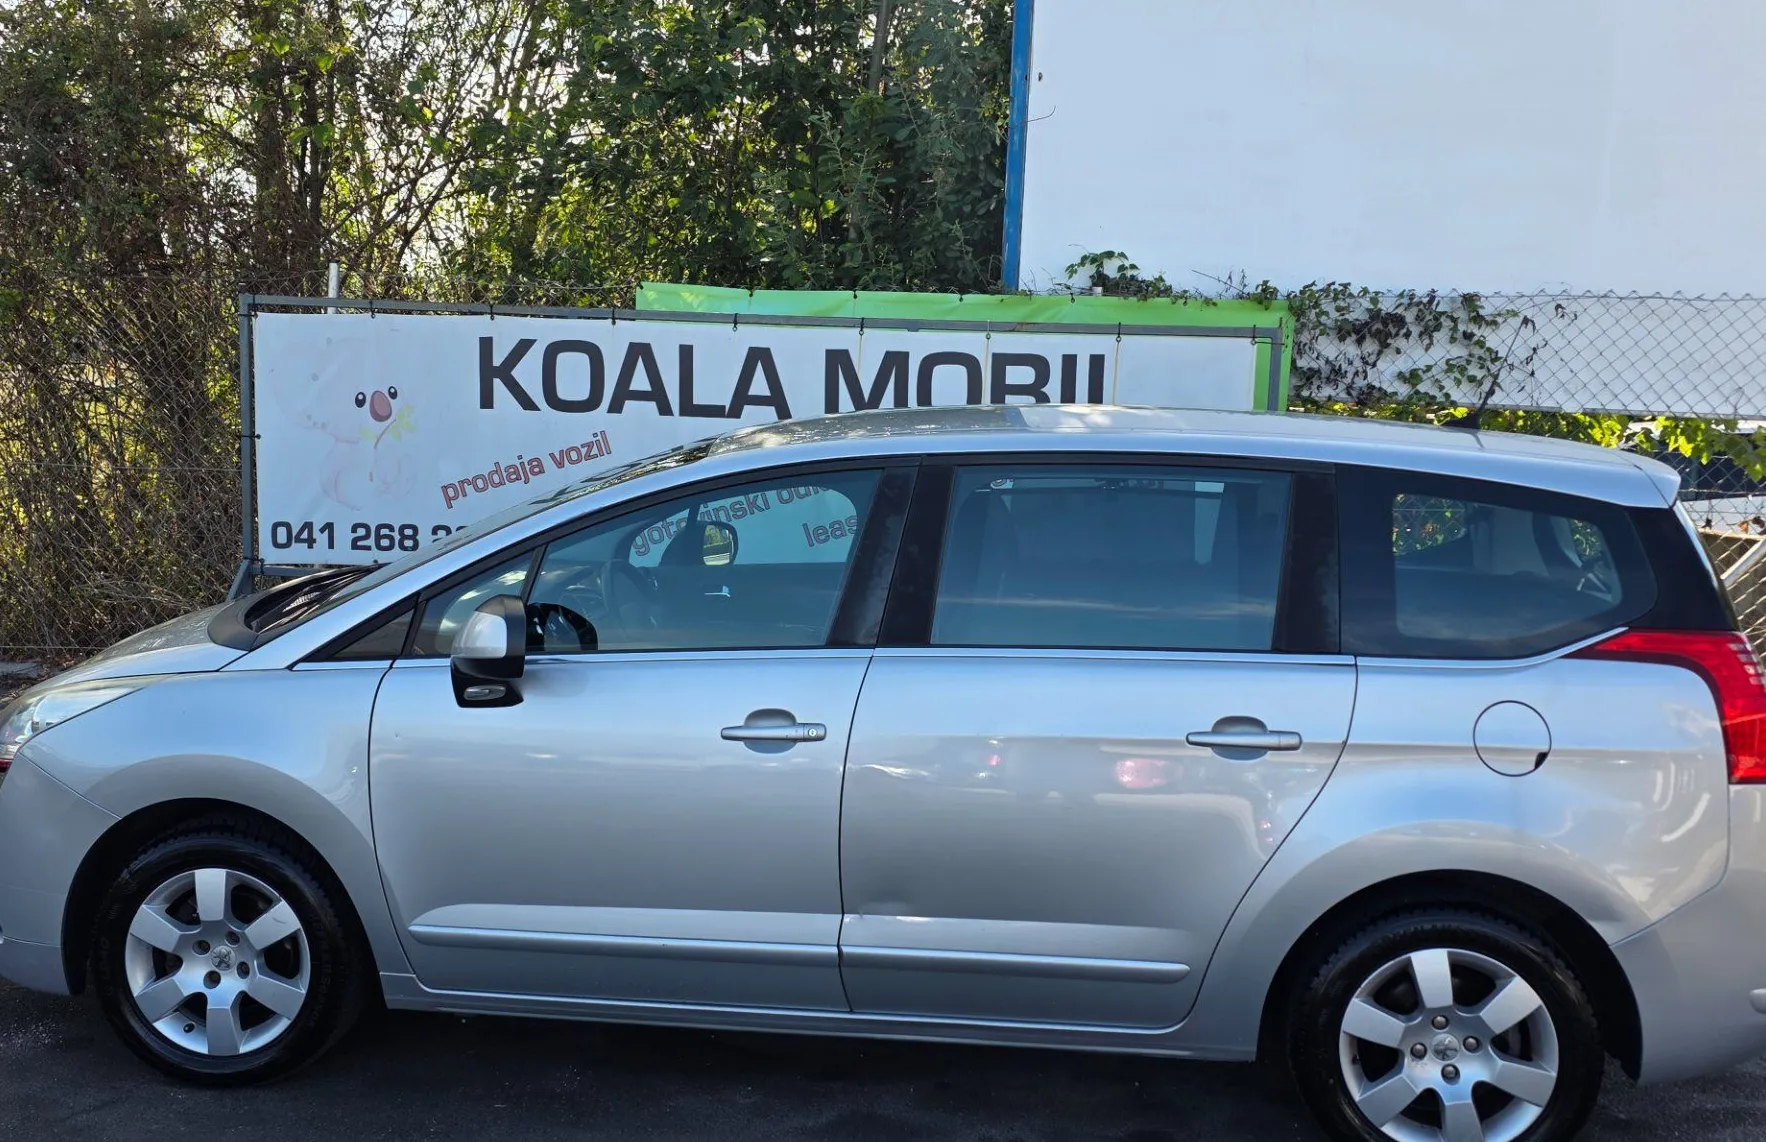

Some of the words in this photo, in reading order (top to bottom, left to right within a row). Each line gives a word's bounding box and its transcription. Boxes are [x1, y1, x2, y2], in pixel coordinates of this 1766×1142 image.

[478, 336, 792, 420] KOALA
[440, 455, 545, 509] prodaja
[549, 430, 612, 469] vozil
[271, 521, 335, 550] 041
[350, 522, 420, 552] 268
